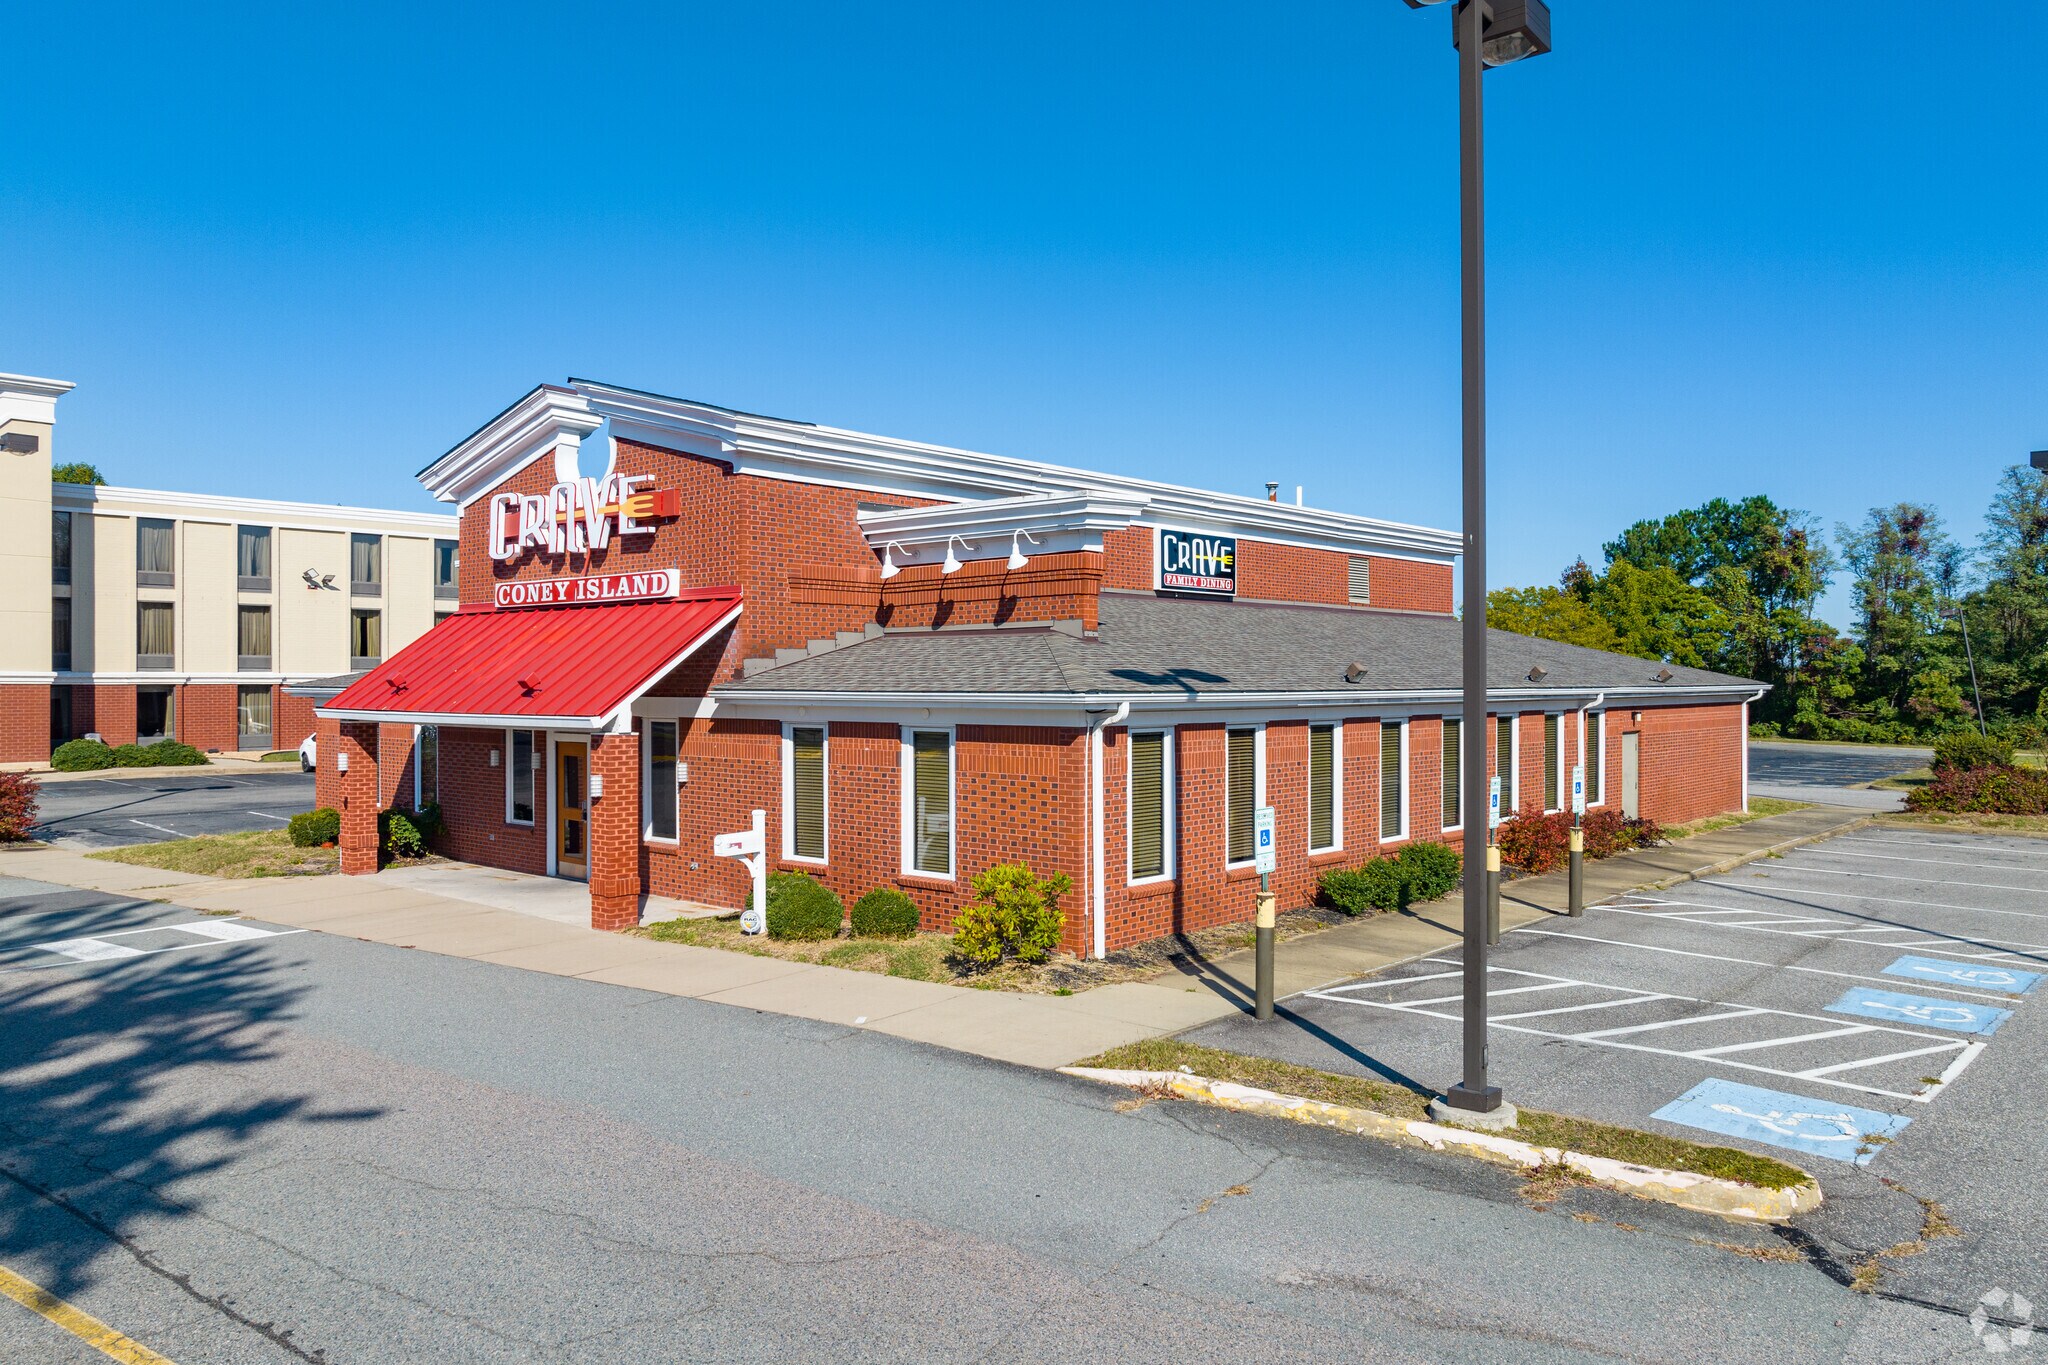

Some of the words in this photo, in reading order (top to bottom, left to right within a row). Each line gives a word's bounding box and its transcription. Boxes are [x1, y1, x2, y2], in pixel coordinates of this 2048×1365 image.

[489, 472, 656, 560] CRAVE
[1163, 534, 1232, 576] CRAVE
[499, 581, 569, 604] CONEY
[576, 573, 669, 599] ISLAND
[1166, 574, 1199, 586] FAMILY
[1200, 577, 1231, 589] DINING
